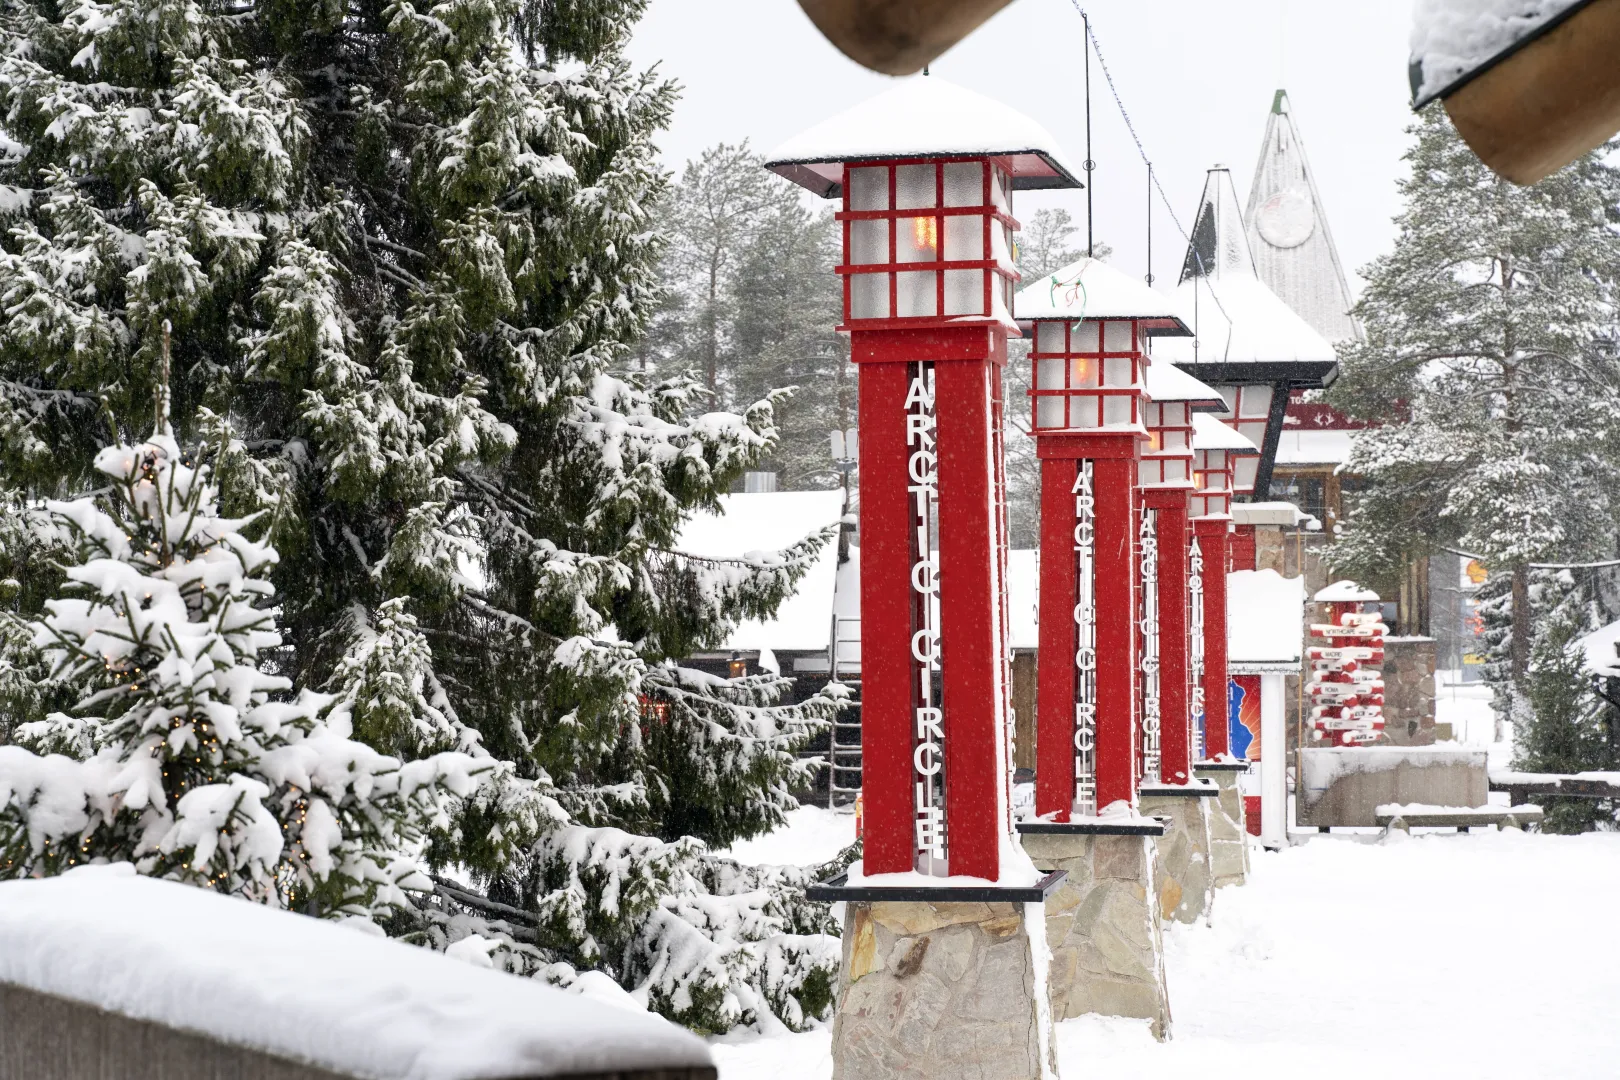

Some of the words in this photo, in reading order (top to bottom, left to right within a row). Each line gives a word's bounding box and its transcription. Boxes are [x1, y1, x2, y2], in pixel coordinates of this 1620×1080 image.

[904, 377, 939, 595] ARCTIC
[1071, 471, 1096, 626] ARCTIC
[911, 629, 945, 851] CIRCLE
[1074, 648, 1097, 806] CIRCLE
